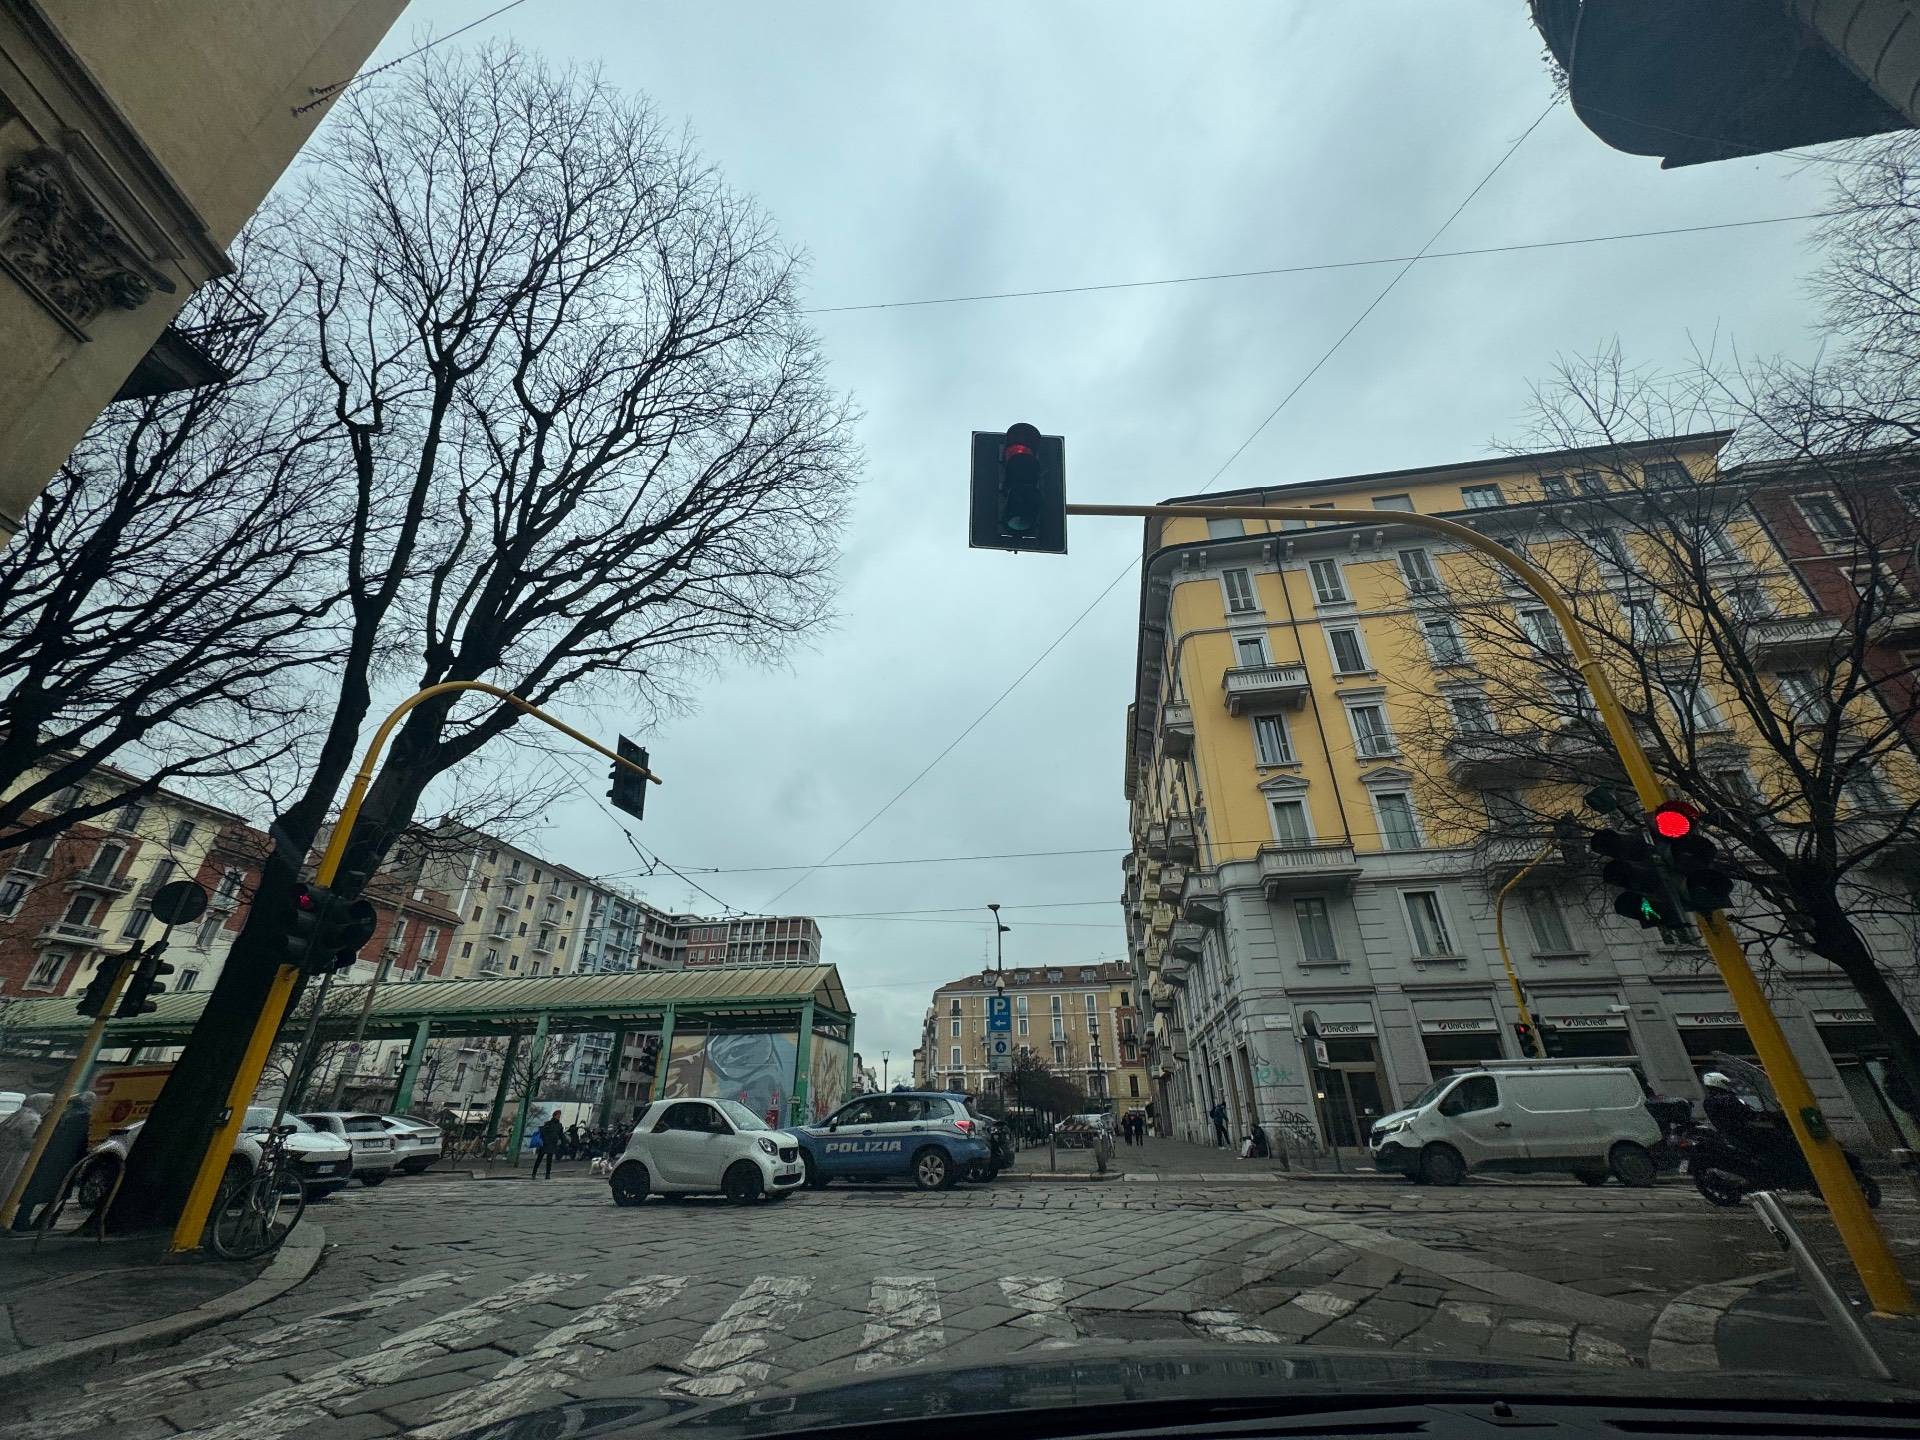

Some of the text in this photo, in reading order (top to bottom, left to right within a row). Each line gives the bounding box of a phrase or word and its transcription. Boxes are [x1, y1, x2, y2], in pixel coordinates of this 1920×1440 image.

[994, 998, 1006, 1015] P
[1447, 1021, 1480, 1030] UniCredit
[1572, 1016, 1608, 1027] UniCredit
[1326, 1023, 1359, 1033] UniCredit
[825, 1140, 902, 1153] POLIZIA
